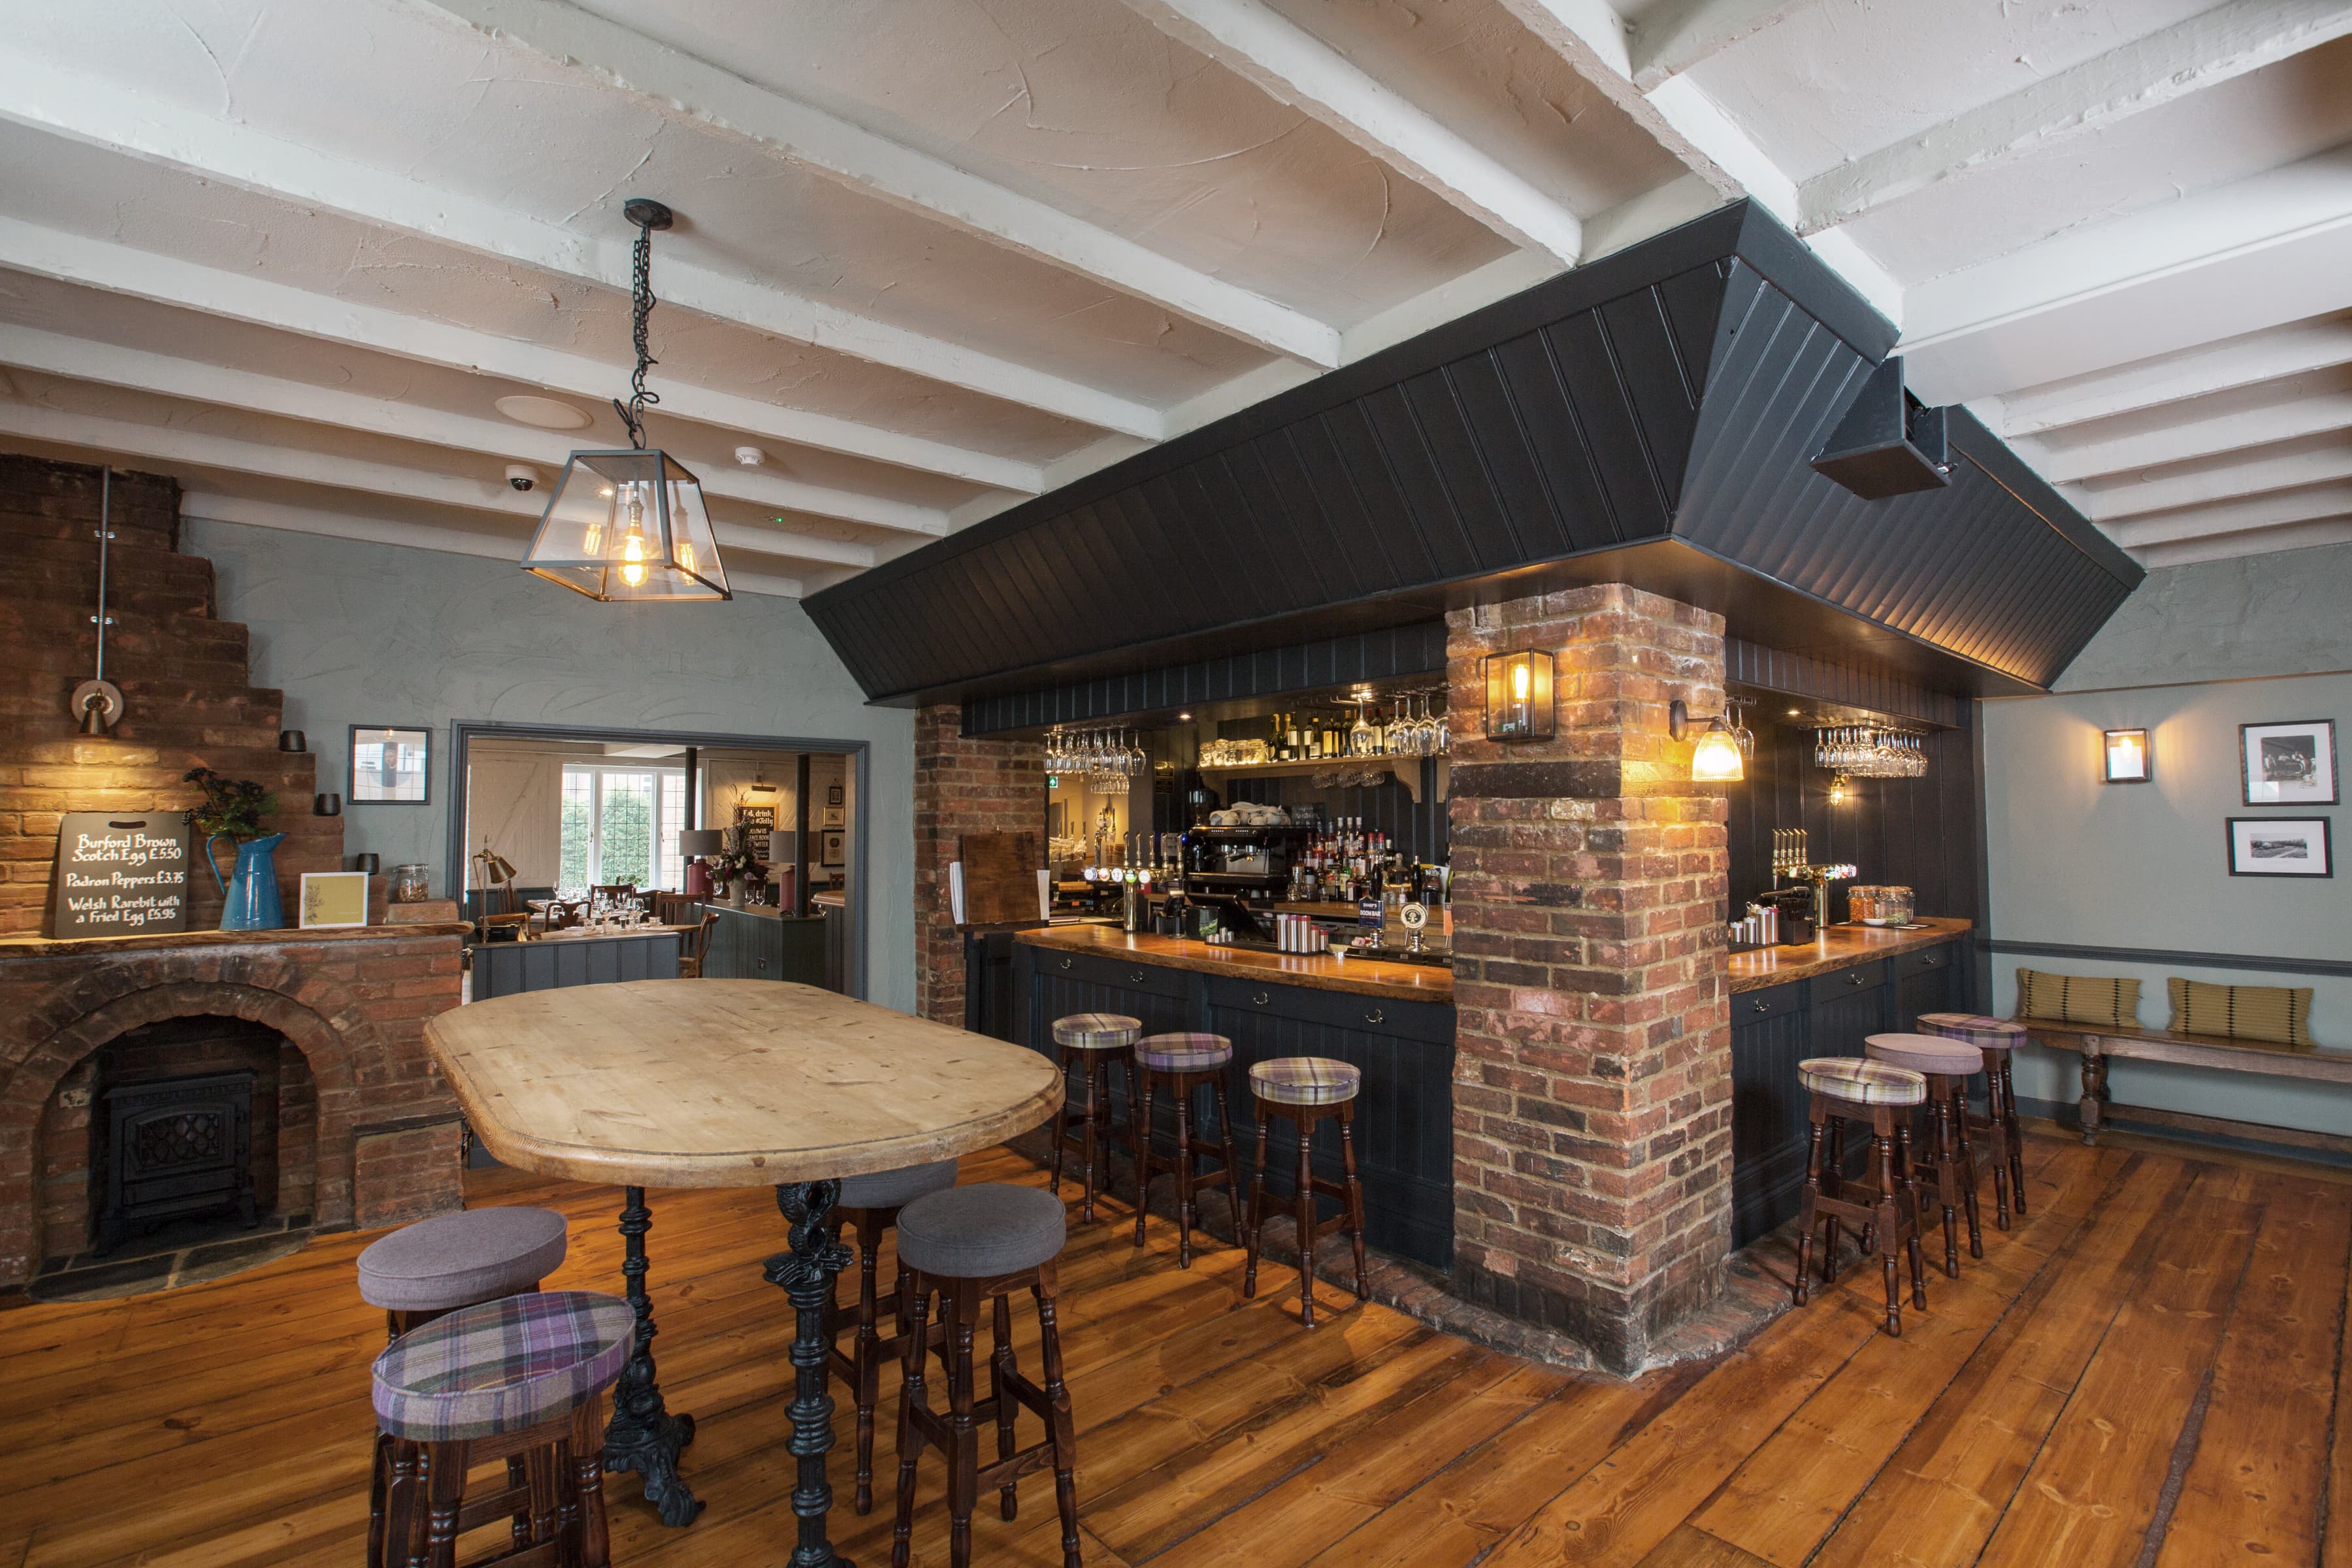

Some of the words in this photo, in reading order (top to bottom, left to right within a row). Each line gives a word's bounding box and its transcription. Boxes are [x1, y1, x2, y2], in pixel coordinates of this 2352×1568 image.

[755, 809, 774, 818] drink,
[755, 817, 774, 826] #Jolly
[76, 834, 131, 851] Burford
[134, 833, 177, 848] Brown
[72, 849, 119, 862] Scotch
[120, 848, 147, 867] Egg
[65, 873, 110, 887] Padron
[111, 872, 155, 889] Peppers
[156, 870, 184, 884] £3.75
[68, 896, 106, 911] Welsh
[111, 895, 157, 909] Rarebit
[157, 895, 180, 907] with
[75, 914, 85, 923] a
[90, 910, 120, 923] Fried
[123, 909, 145, 926] Egg
